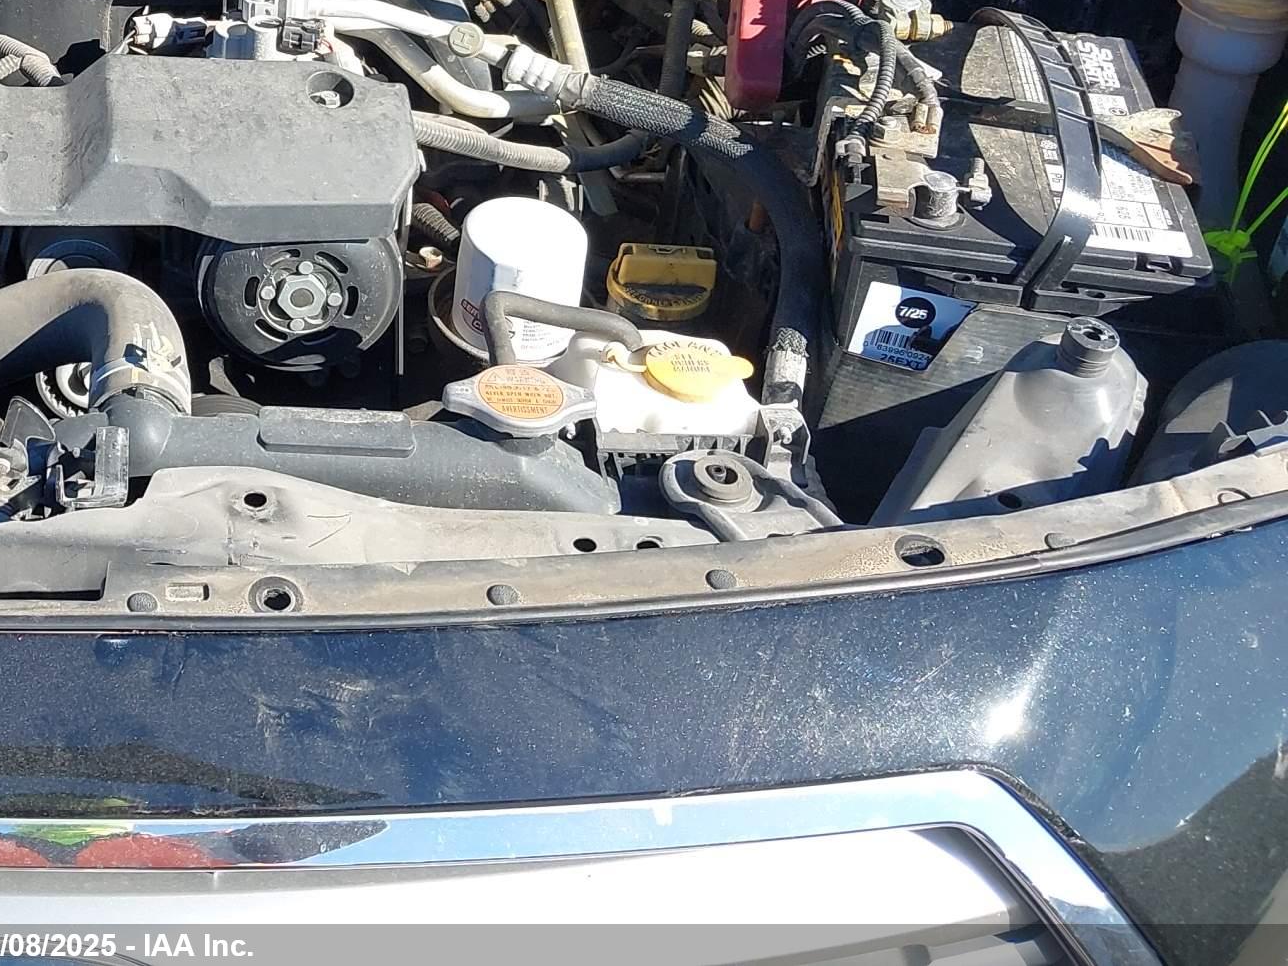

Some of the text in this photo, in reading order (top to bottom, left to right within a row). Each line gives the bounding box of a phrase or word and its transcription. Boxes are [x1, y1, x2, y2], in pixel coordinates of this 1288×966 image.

[1076, 39, 1106, 89] START
[1100, 48, 1121, 89] SUPER
[899, 306, 928, 320] 7/25
